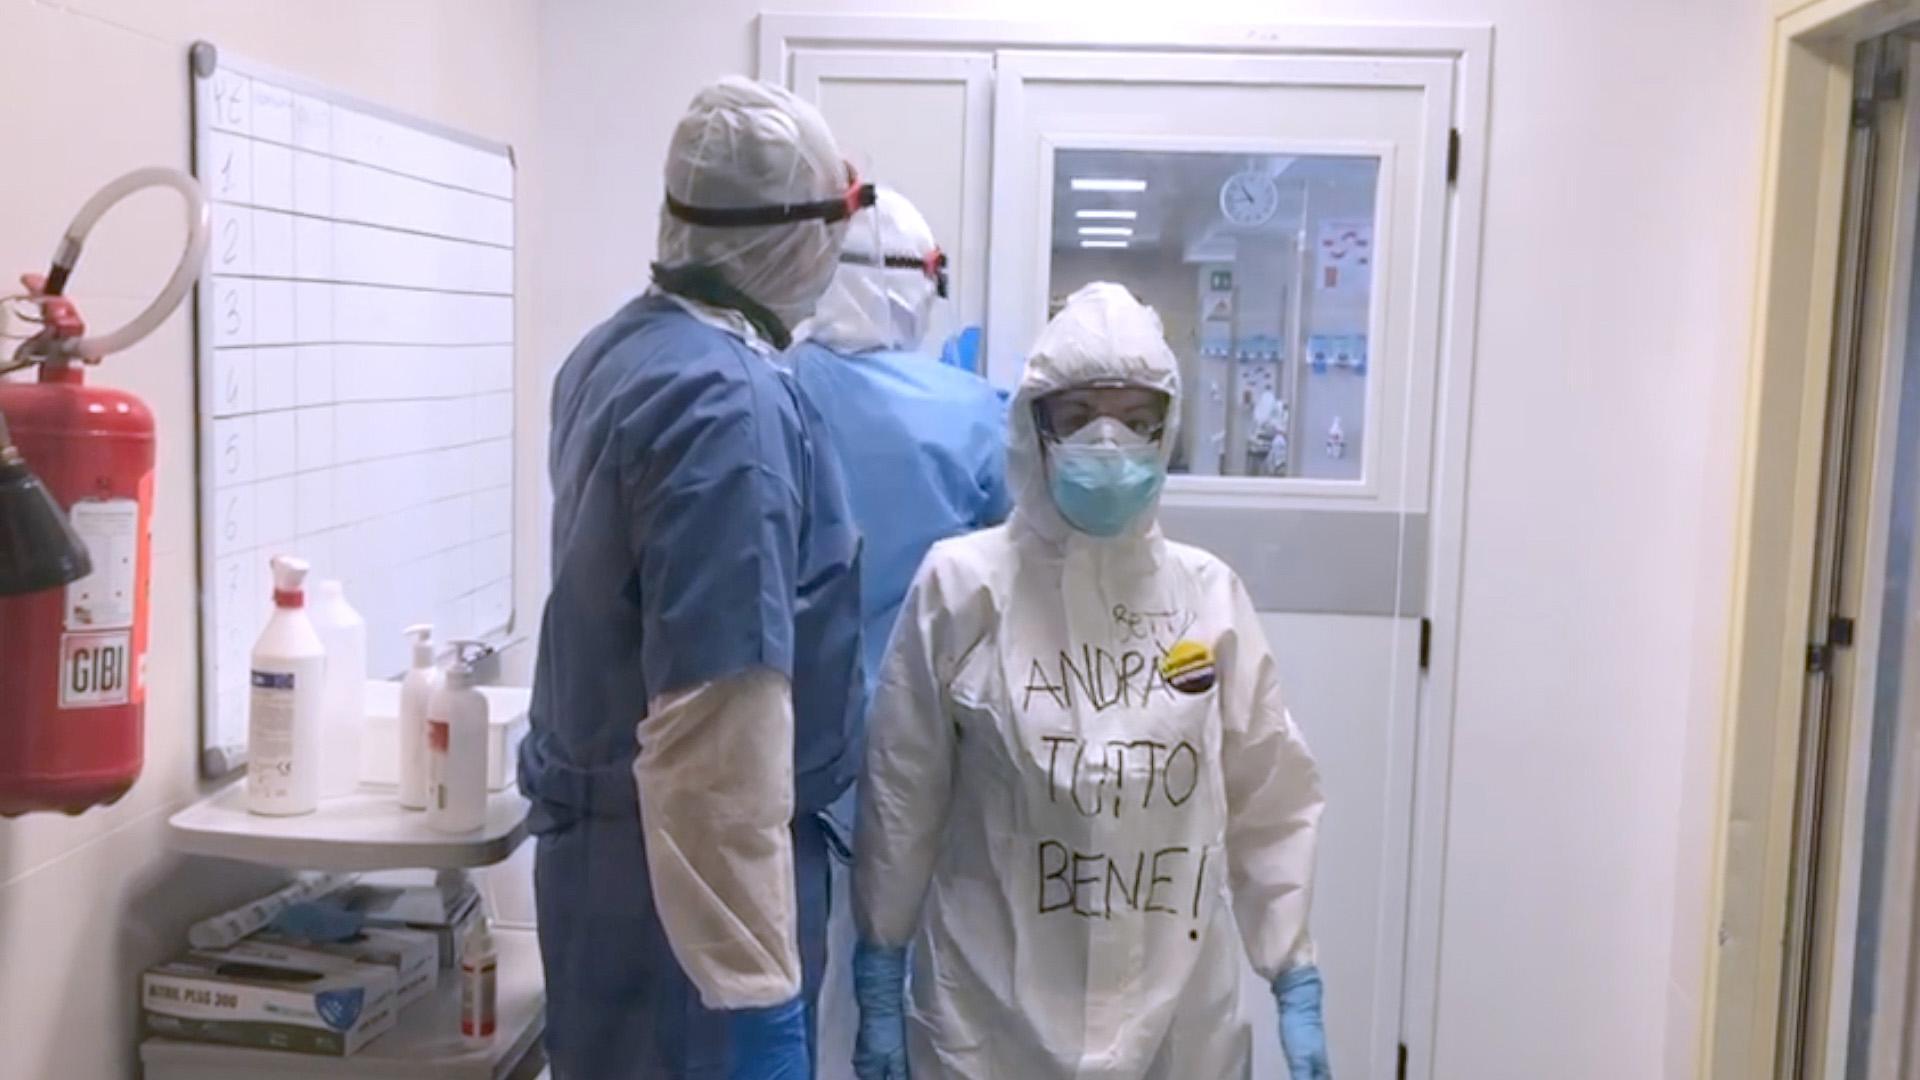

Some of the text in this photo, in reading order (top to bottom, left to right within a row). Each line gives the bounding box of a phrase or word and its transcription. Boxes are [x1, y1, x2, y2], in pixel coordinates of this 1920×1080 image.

[221, 216, 240, 265] 2
[223, 287, 242, 336] 3
[224, 431, 241, 476] 5
[222, 495, 240, 543] 6
[72, 645, 124, 693] GIBI
[1040, 734, 1198, 818] TUTTO
[1037, 840, 1208, 940] BENE!
